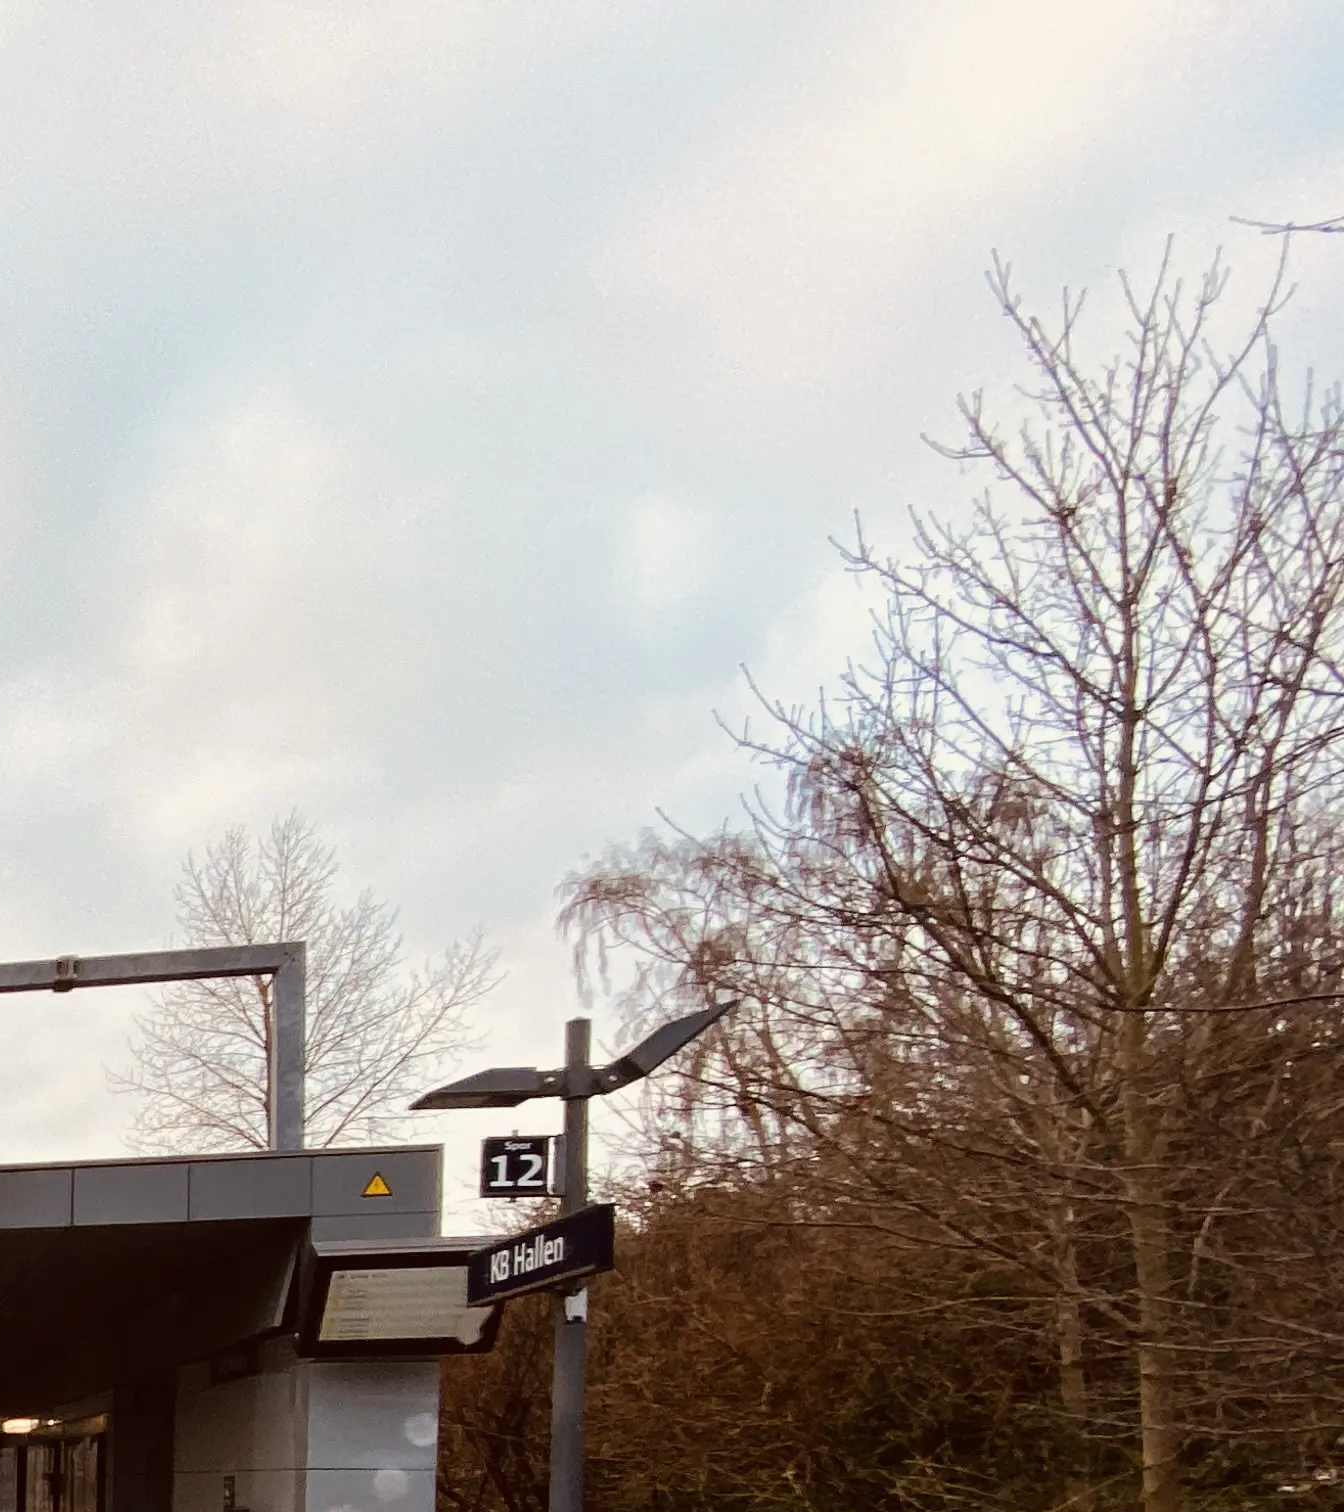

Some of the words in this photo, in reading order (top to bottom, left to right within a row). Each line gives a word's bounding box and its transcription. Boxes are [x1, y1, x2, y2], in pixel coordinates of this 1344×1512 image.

[490, 1154, 543, 1187] 12
[490, 1249, 509, 1283] KB
[514, 1234, 564, 1276] Hallen
